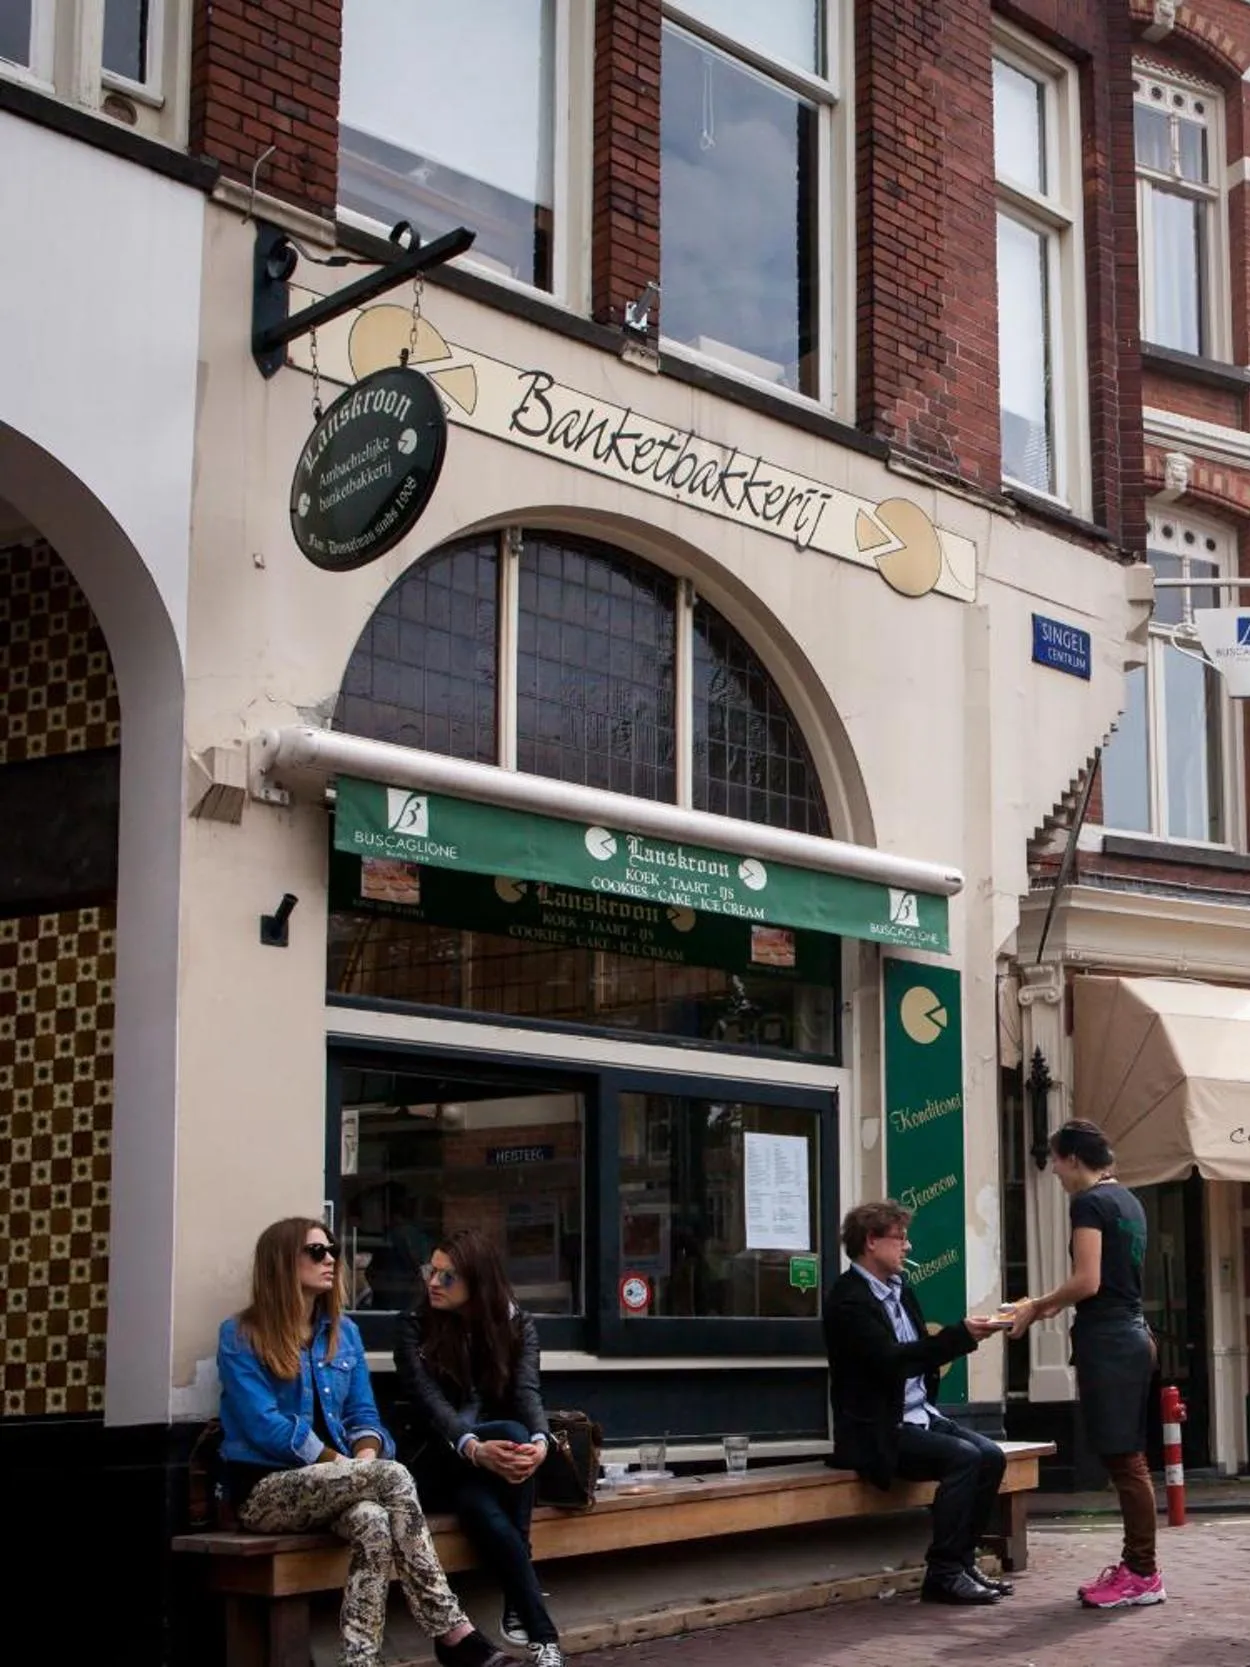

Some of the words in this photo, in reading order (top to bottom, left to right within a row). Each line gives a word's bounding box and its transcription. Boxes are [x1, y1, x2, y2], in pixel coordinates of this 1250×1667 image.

[301, 387, 412, 474] Lanskroon
[509, 370, 832, 553] Banketbakkerij
[1041, 622, 1086, 655] SINGEL
[1047, 646, 1087, 672] CENTRUM
[354, 830, 460, 860] BUSCAGLIONE
[625, 833, 730, 878] Lanskroon
[591, 875, 650, 898] COOKIES
[657, 889, 693, 907] CAKE
[701, 897, 720, 912] ICE
[722, 901, 767, 920] CREAM
[625, 867, 660, 886] KOEK
[670, 876, 711, 896] TAART
